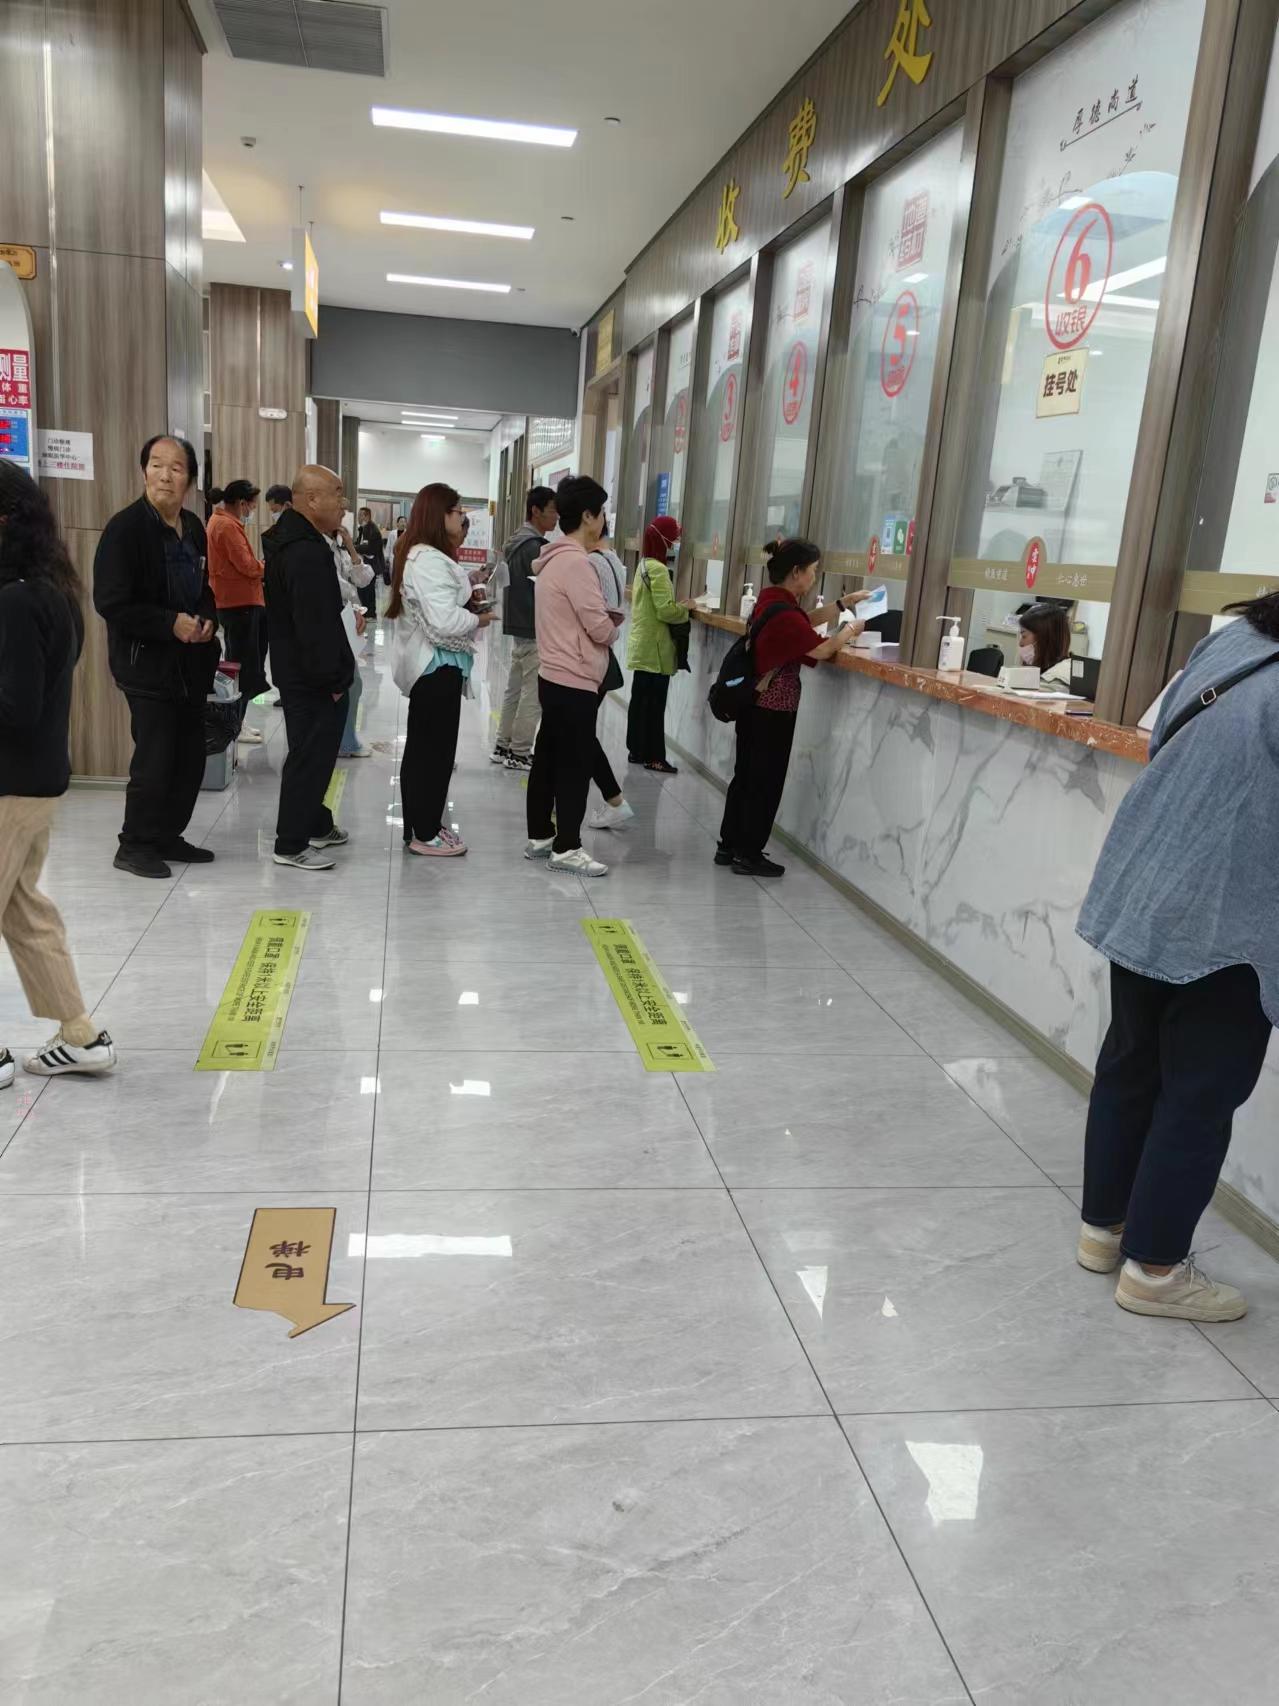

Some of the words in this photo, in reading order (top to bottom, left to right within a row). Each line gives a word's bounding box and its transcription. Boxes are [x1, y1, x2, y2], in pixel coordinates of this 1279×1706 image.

[715, 0, 933, 256] 收费处
[1064, 218, 1098, 304] 6
[889, 303, 910, 367] 5
[1055, 304, 1088, 336] 收银
[1043, 369, 1078, 397] 挂号处
[264, 1240, 312, 1281] 电梯
